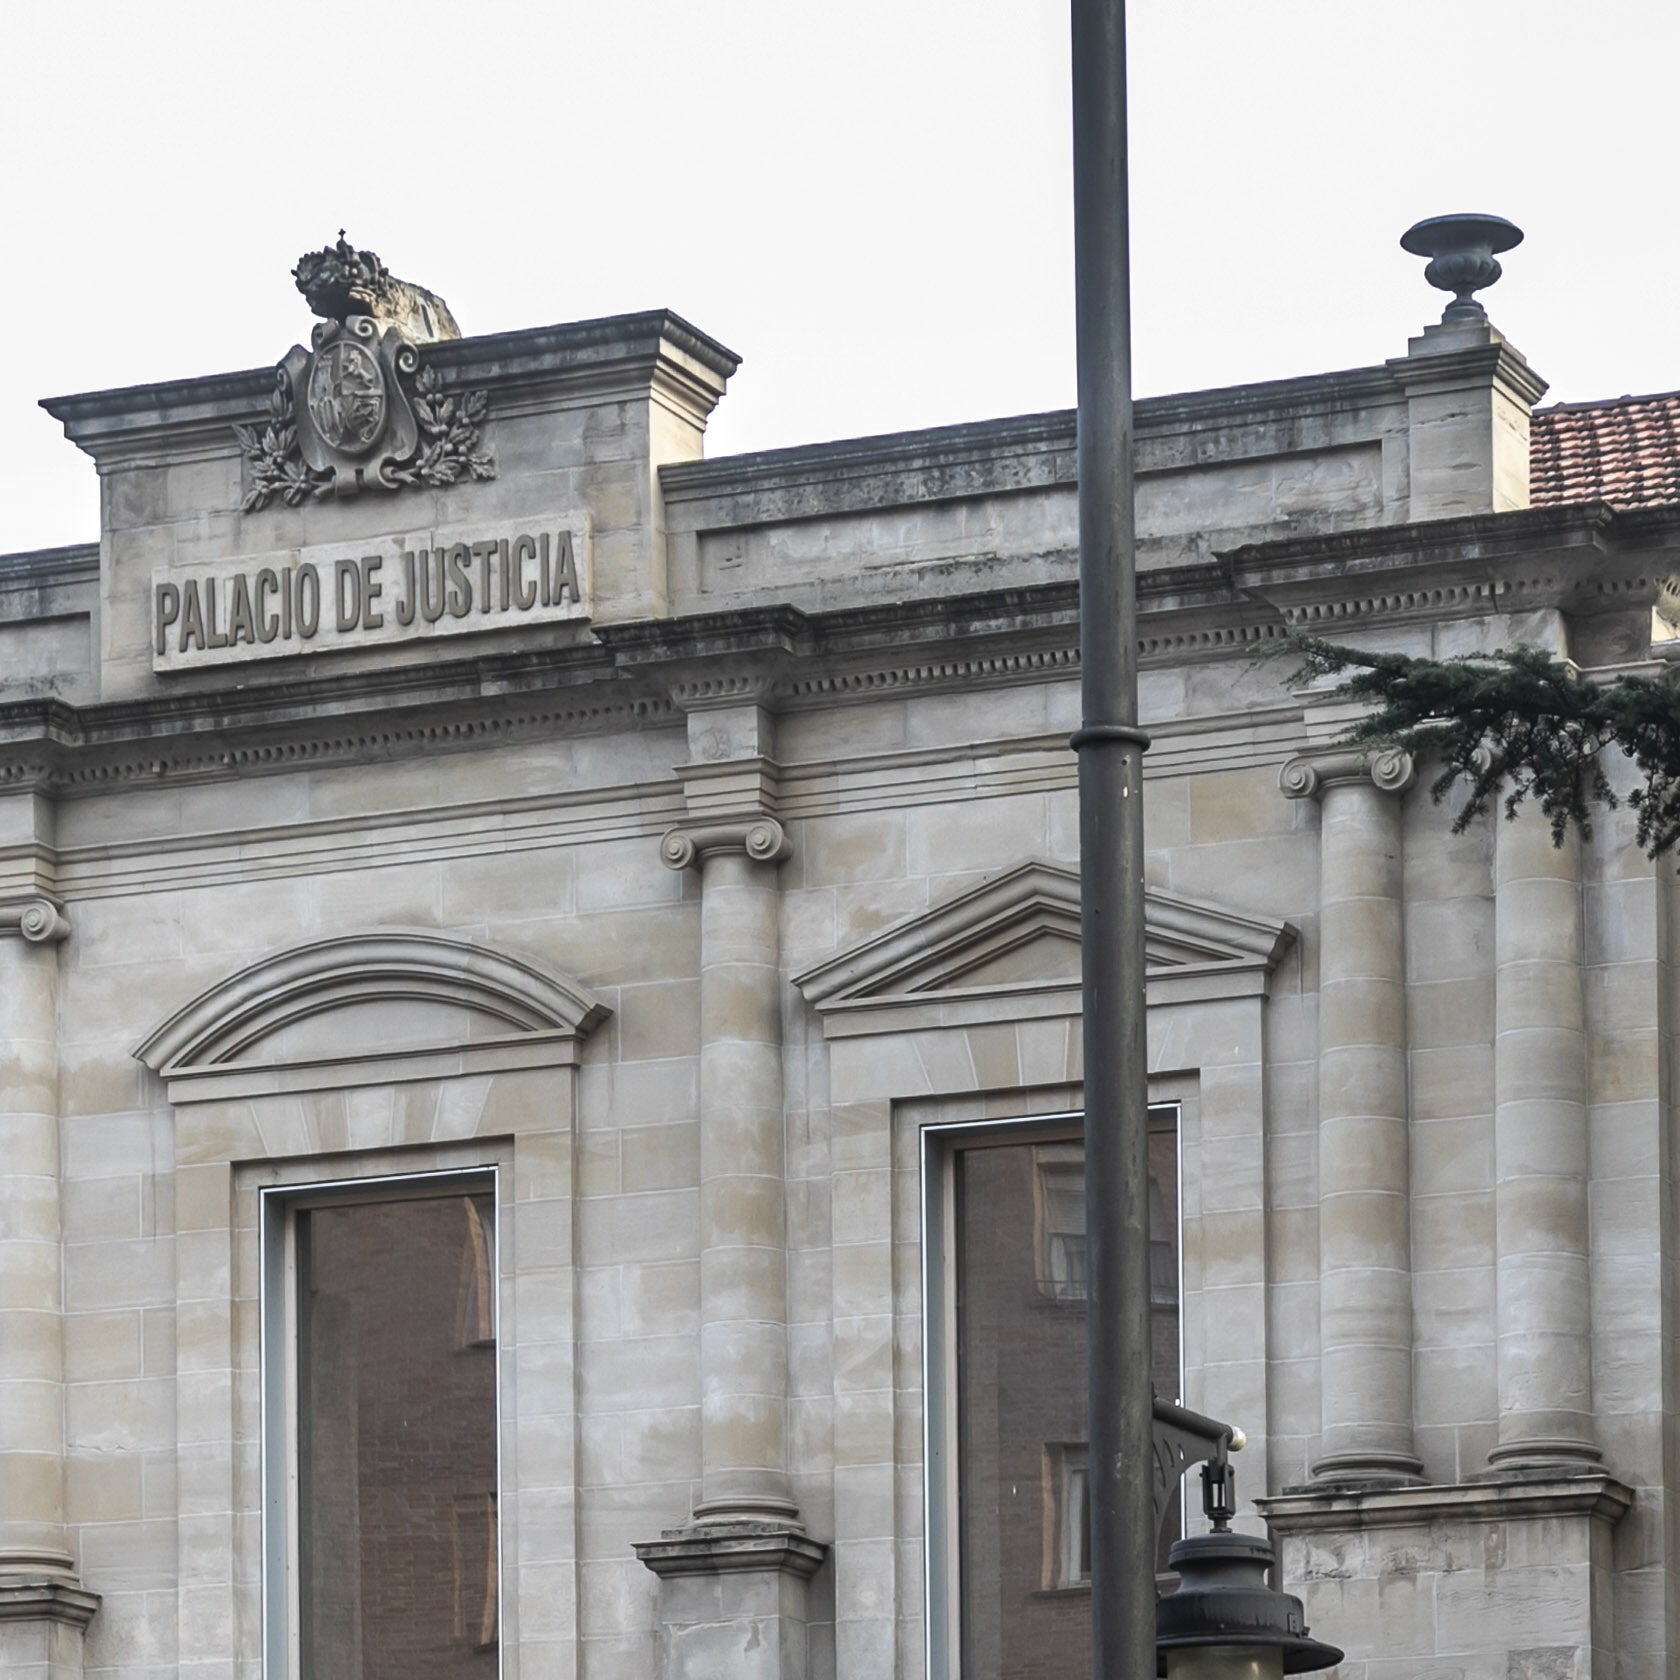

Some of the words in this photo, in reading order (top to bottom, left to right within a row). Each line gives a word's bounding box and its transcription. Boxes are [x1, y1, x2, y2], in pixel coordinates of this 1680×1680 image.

[155, 562, 321, 656] PALACIO
[334, 554, 384, 634] DE
[396, 529, 581, 626] JUSTICIA
